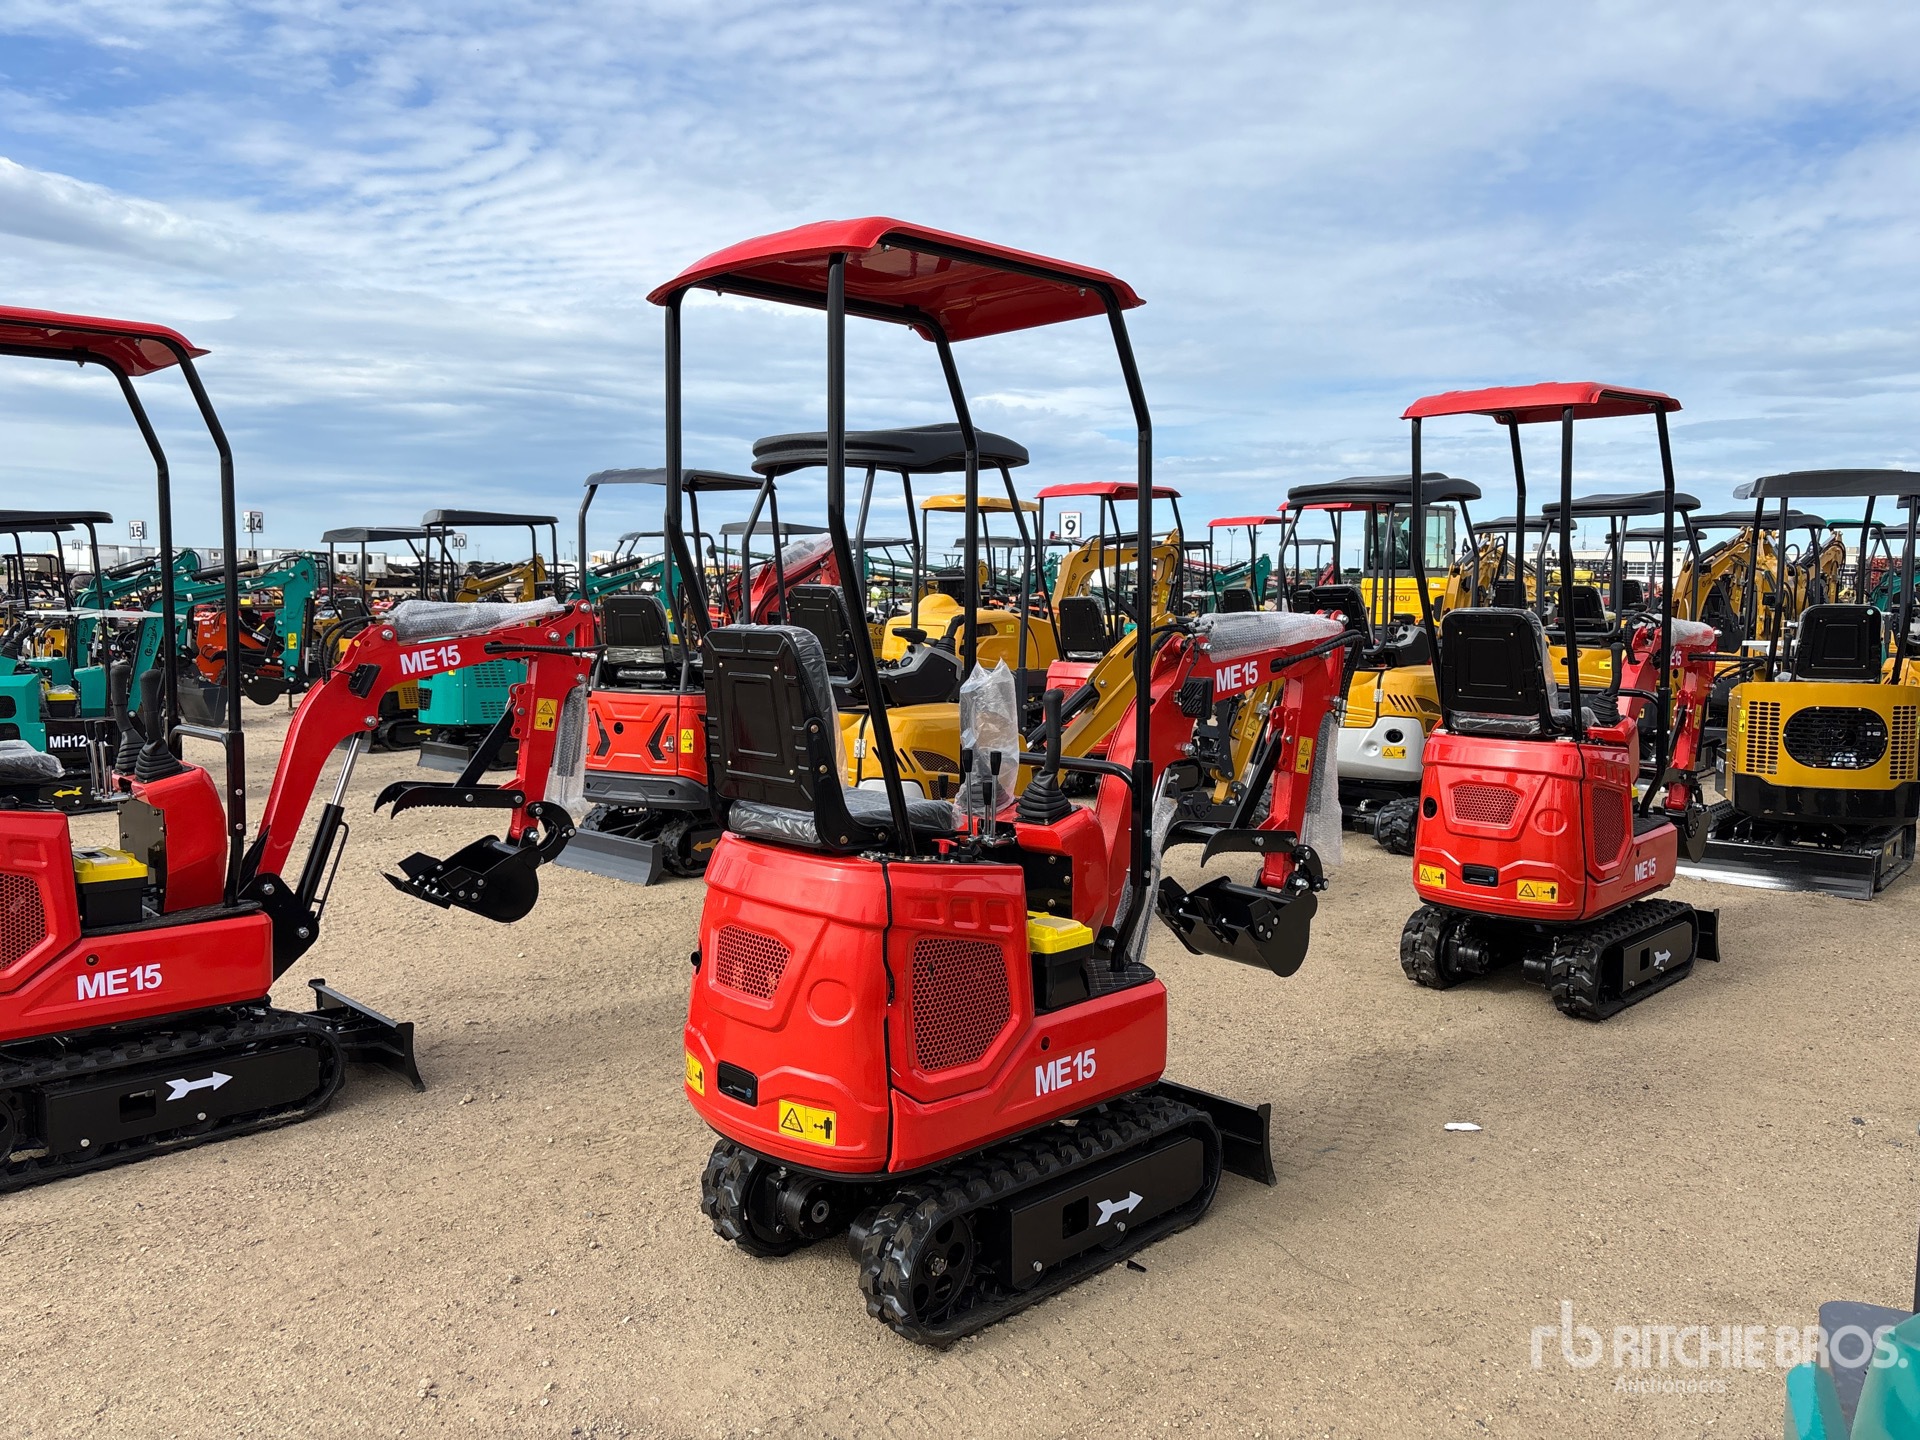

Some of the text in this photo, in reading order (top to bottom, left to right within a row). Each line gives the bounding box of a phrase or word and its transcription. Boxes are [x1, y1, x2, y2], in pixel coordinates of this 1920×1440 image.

[131, 526, 143, 537] 15
[251, 518, 262, 530] 14
[1065, 519, 1076, 535] 9
[454, 538, 465, 547] 10
[399, 644, 461, 675] ME15
[1216, 660, 1259, 693] ME15
[1633, 856, 1657, 882] ME15
[76, 963, 163, 1000] ME15
[1034, 1048, 1097, 1097] ME15
